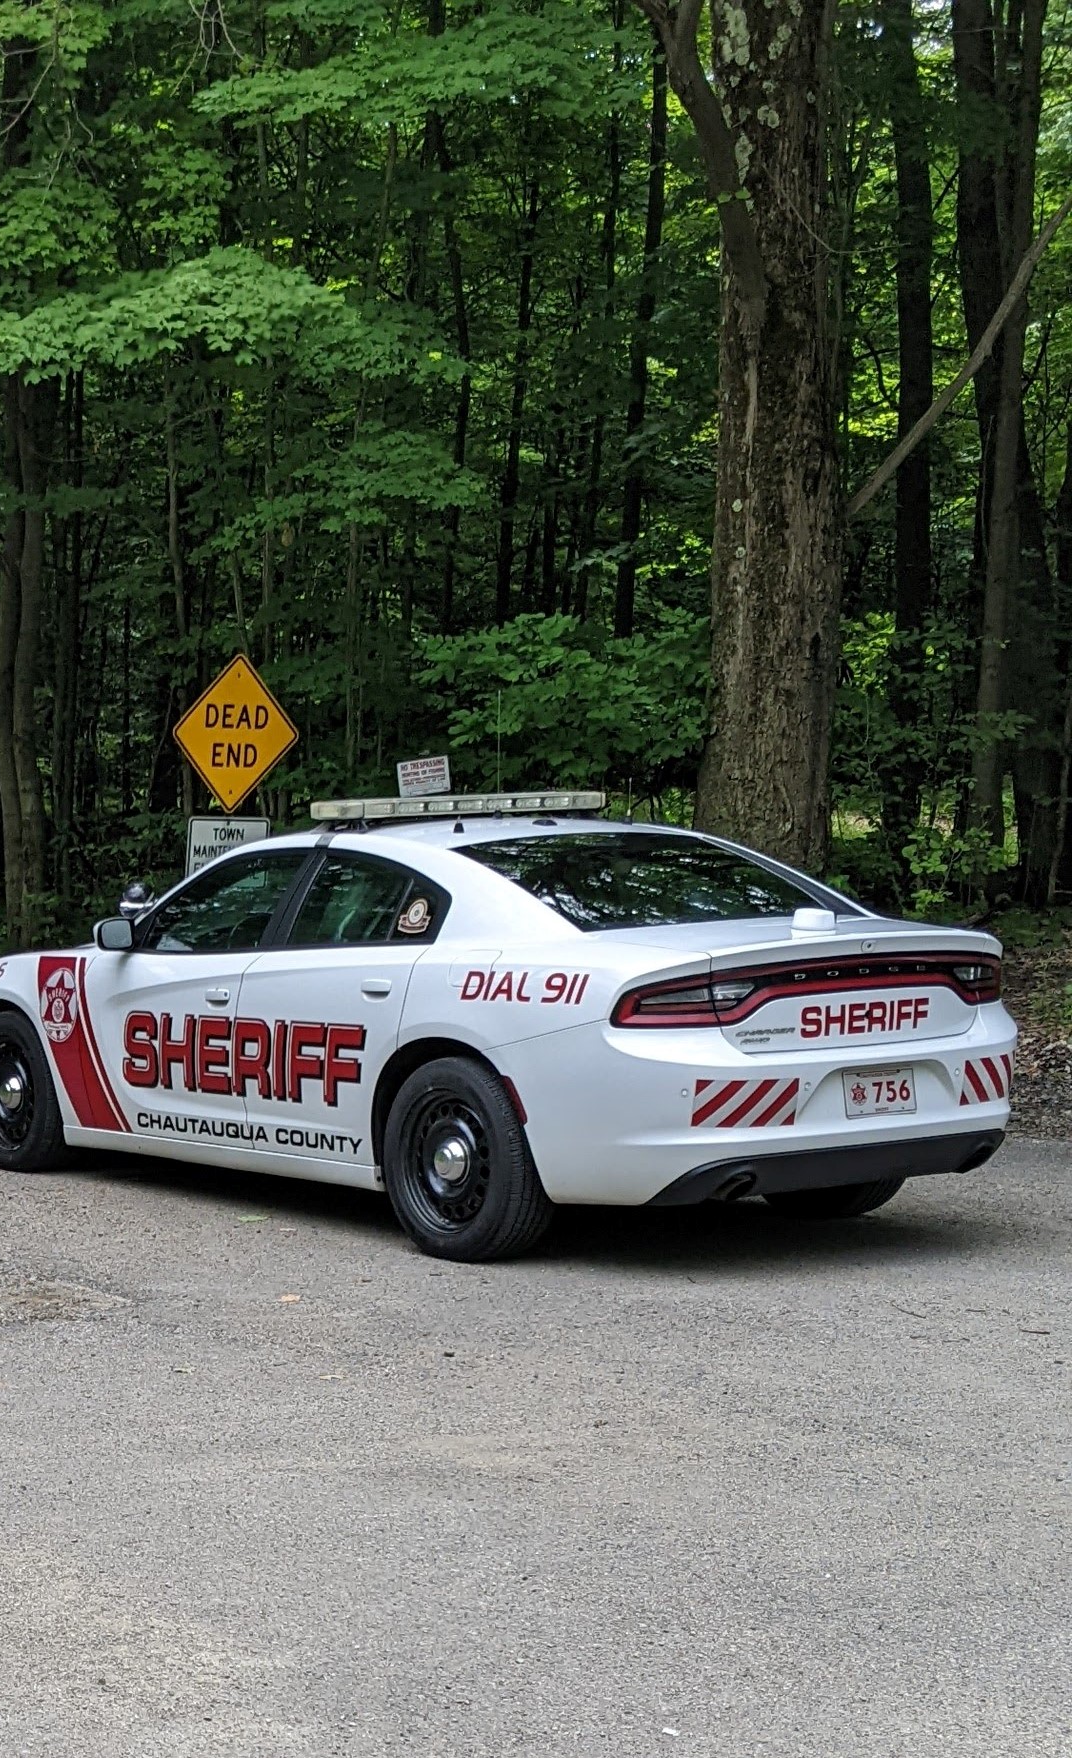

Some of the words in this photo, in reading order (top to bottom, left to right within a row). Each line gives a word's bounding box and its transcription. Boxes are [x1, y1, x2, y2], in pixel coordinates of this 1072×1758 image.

[205, 703, 269, 729] DEAD
[211, 743, 258, 768] END
[410, 758, 445, 770] TRESPASSING
[213, 828, 245, 841] TOWN
[794, 964, 926, 980] DODGE
[460, 971, 531, 1002] DIAL
[540, 972, 590, 1005] 911
[800, 998, 930, 1038] SHERIFF
[123, 1010, 367, 1107] SHERIFF
[872, 1079, 911, 1103] 756
[137, 1112, 269, 1142] CHAUTAUQUA
[275, 1128, 363, 1155] COUNTY
